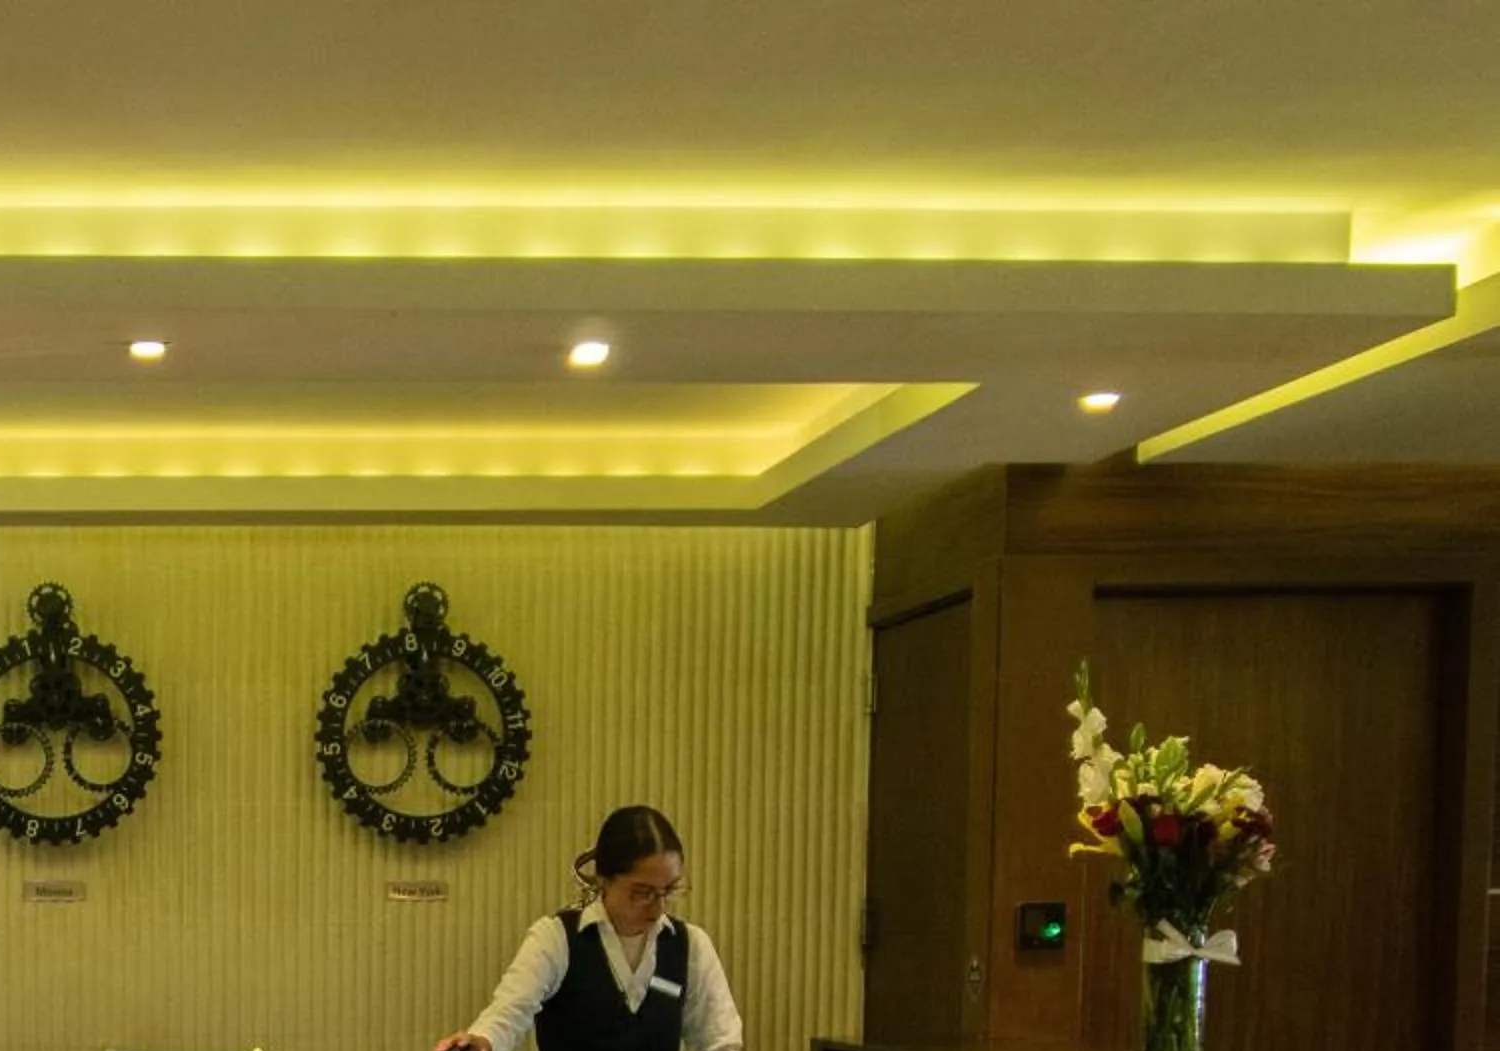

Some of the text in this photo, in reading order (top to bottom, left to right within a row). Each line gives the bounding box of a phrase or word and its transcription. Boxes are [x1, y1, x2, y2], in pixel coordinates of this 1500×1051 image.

[21, 640, 31, 656] 1
[68, 637, 83, 655] 2
[404, 635, 418, 651] 8
[451, 639, 468, 656] 9
[110, 660, 126, 676] 3
[358, 653, 373, 671] 7
[487, 666, 508, 688] 10
[329, 692, 347, 708] 6
[134, 704, 150, 717] 4
[507, 712, 523, 729] 11
[324, 743, 341, 756] 5
[135, 753, 153, 766] 5
[499, 759, 519, 780] 12
[342, 785, 358, 800] 4
[112, 795, 129, 810] 6
[26, 819, 39, 837] 8
[75, 820, 87, 837] 7
[381, 813, 397, 832] 3
[431, 819, 444, 837] 2
